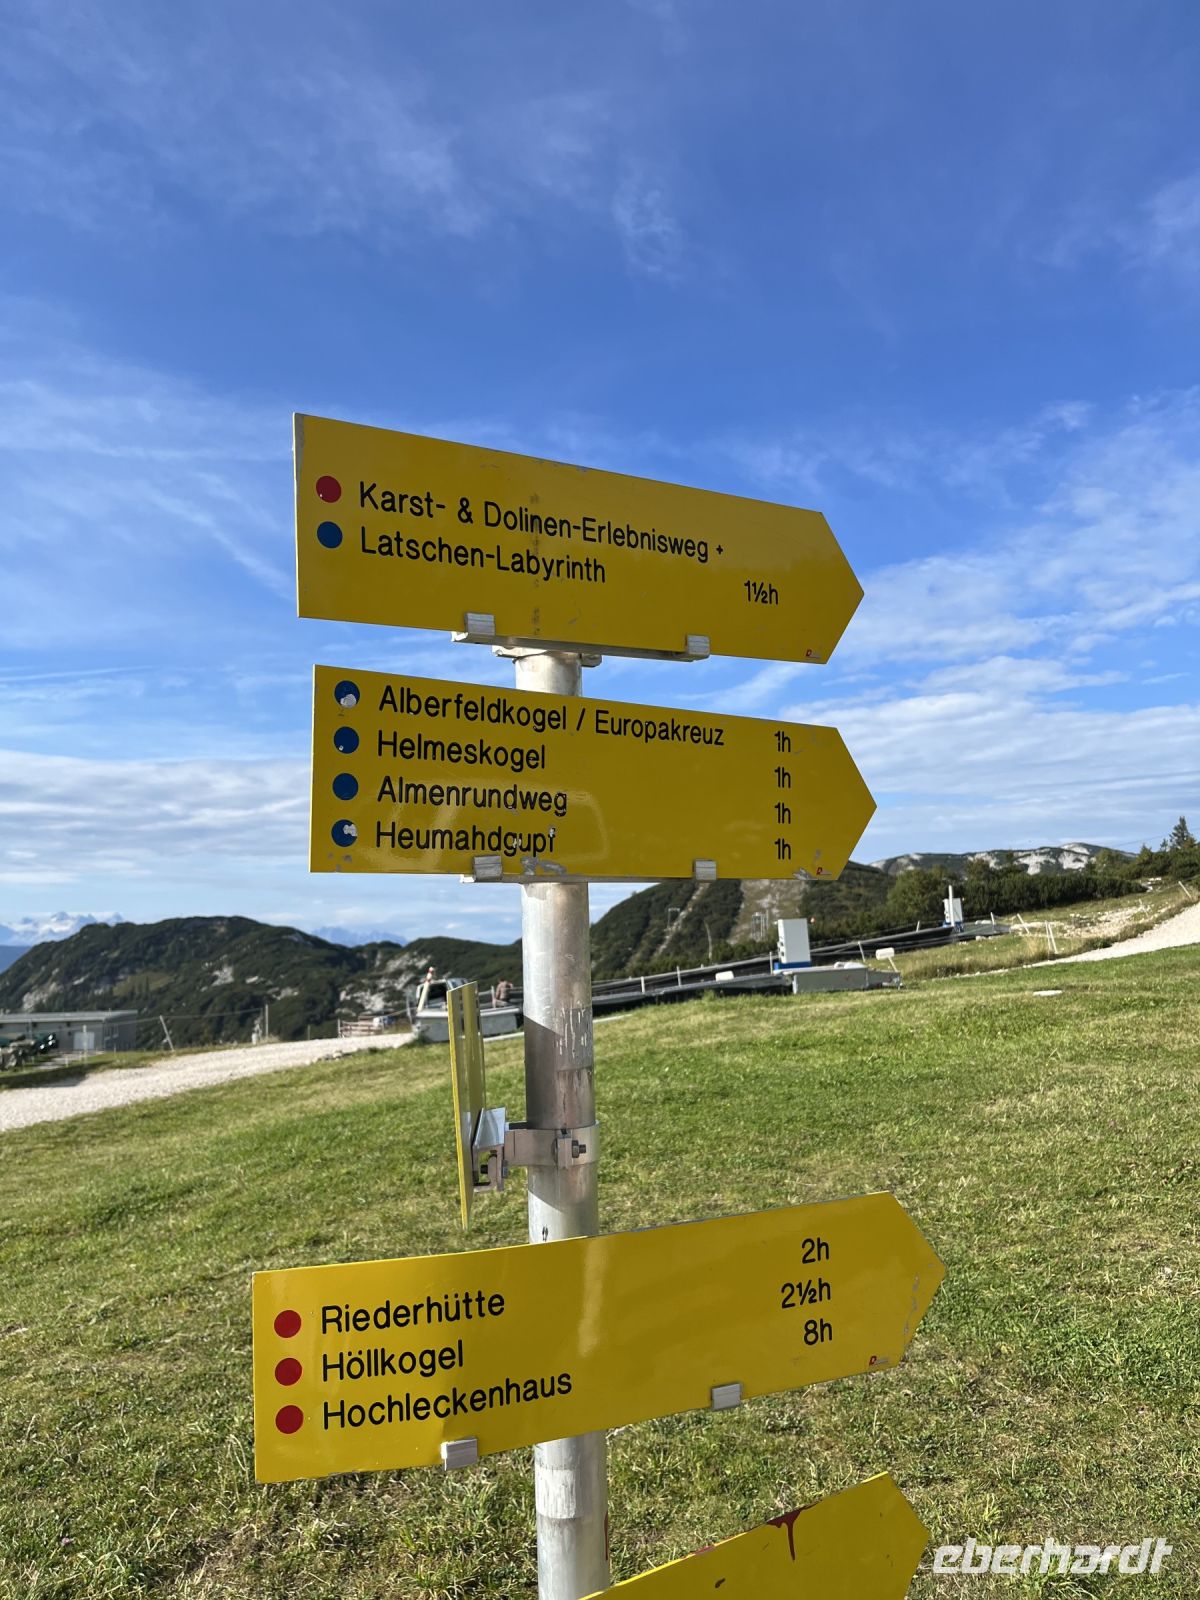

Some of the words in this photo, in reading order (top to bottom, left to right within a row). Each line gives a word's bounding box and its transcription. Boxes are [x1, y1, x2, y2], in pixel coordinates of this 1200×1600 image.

[359, 480, 446, 518] Karst-
[457, 496, 474, 524] &
[484, 501, 709, 563] Dolinen-Erlebnisweg
[715, 544, 724, 555] +
[360, 525, 606, 583] Latschen-Labyrinth
[378, 684, 567, 733] Alberfeldkogel
[575, 707, 586, 731] /
[595, 709, 725, 746] Europakreuz
[377, 729, 546, 773] Helmeskogel
[774, 730, 791, 753] 1h
[376, 775, 568, 817] Almenrundweg
[774, 766, 791, 788] 1h
[774, 802, 791, 824] 1h
[376, 820, 556, 857] Heumahdgupf
[774, 838, 791, 860] 1h
[801, 1237, 830, 1264] 2h
[321, 1290, 505, 1335] Riederhütte
[803, 1318, 833, 1346] 8h
[322, 1339, 464, 1382] Höllkogel
[323, 1372, 572, 1430] Hochleckenhaus
